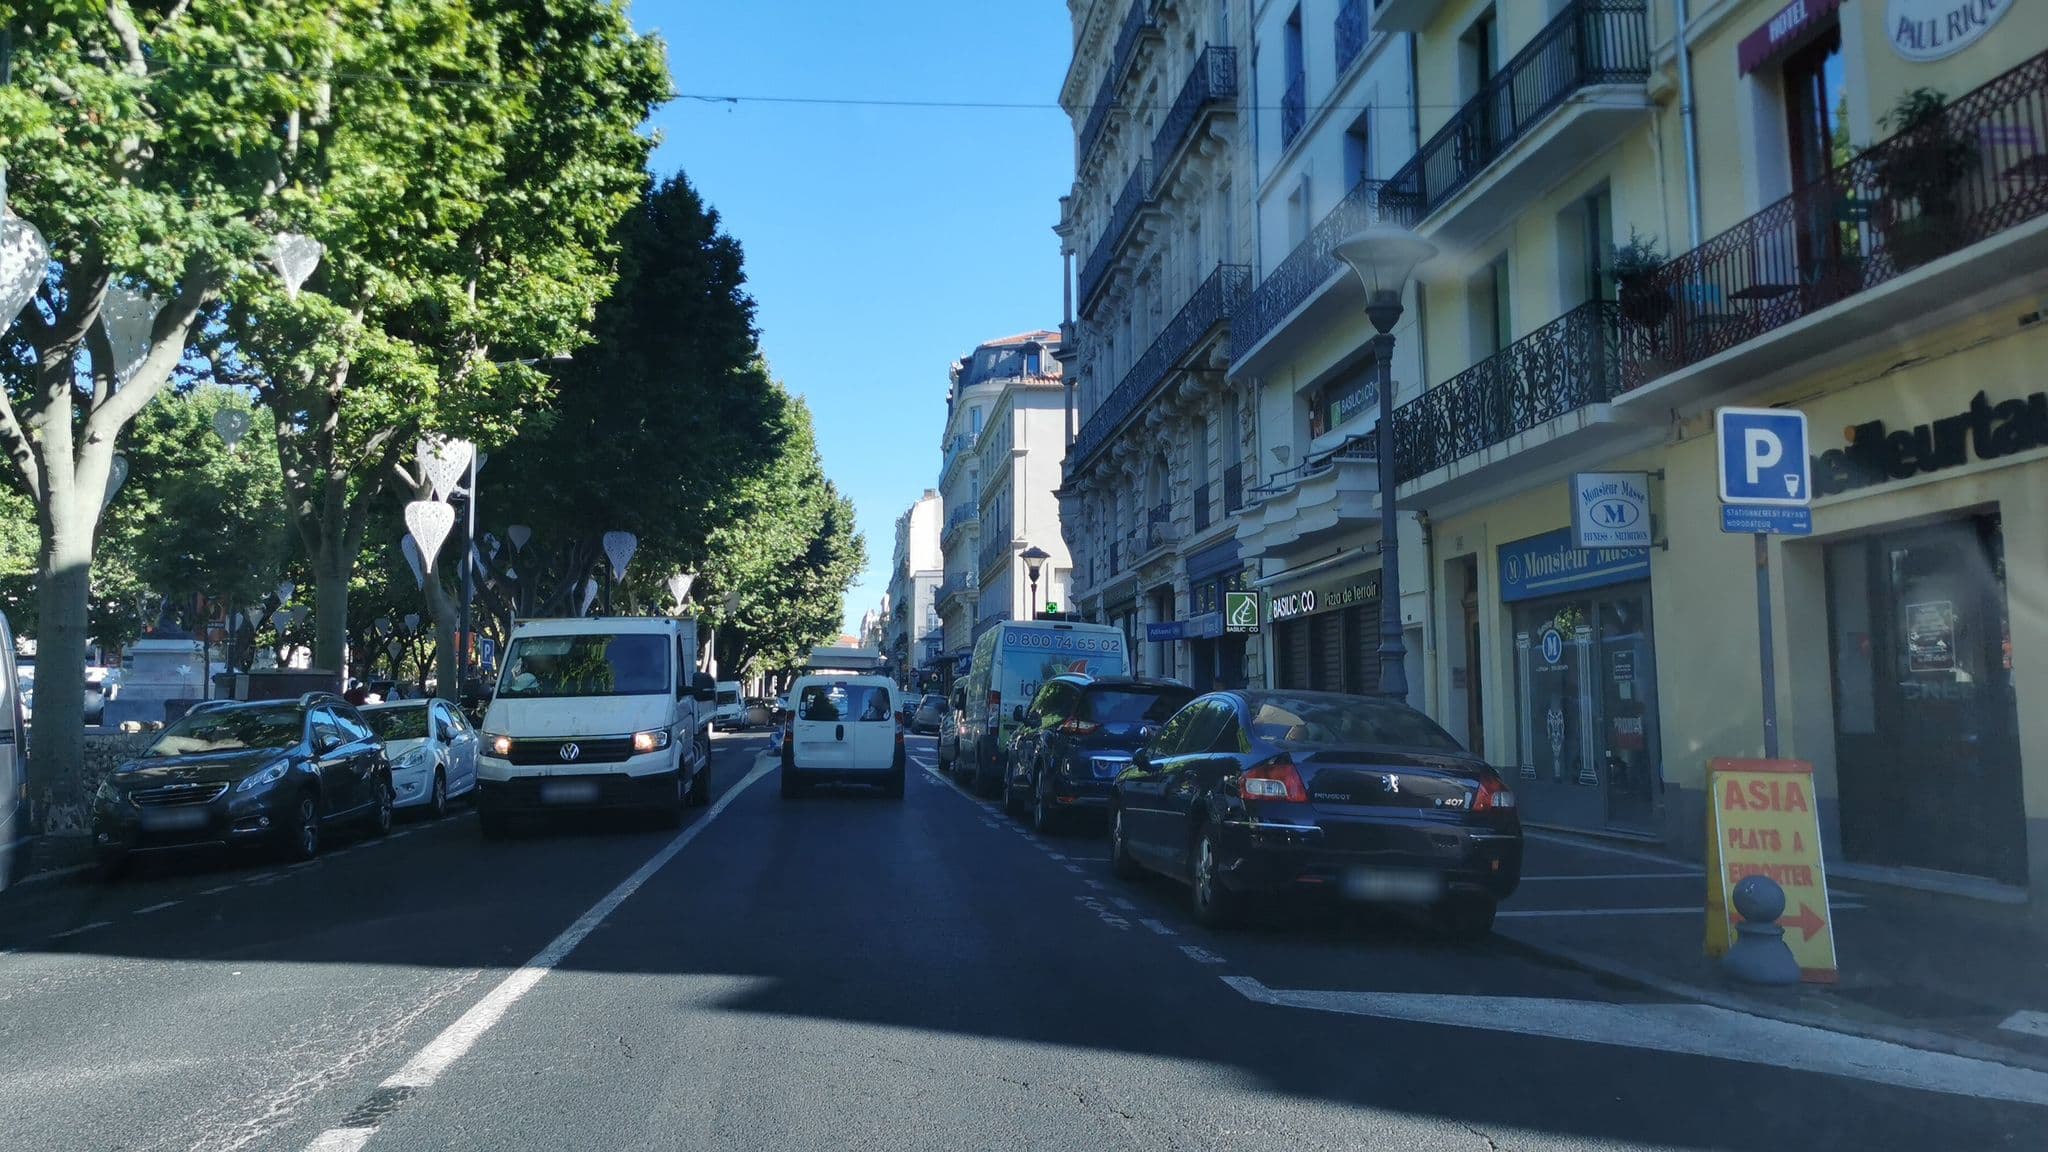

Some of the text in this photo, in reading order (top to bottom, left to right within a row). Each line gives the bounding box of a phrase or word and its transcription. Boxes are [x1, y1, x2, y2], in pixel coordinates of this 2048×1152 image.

[1744, 428, 1783, 484] P
[1603, 504, 1626, 523] M
[1524, 545, 1590, 579] Monsieur
[1343, 586, 1353, 603] de
[1006, 633, 1120, 651] 0 800 74 65 02
[1445, 798, 1463, 807] 407
[1725, 779, 1808, 812] ASIA
[1728, 827, 1804, 852] PLATS A
